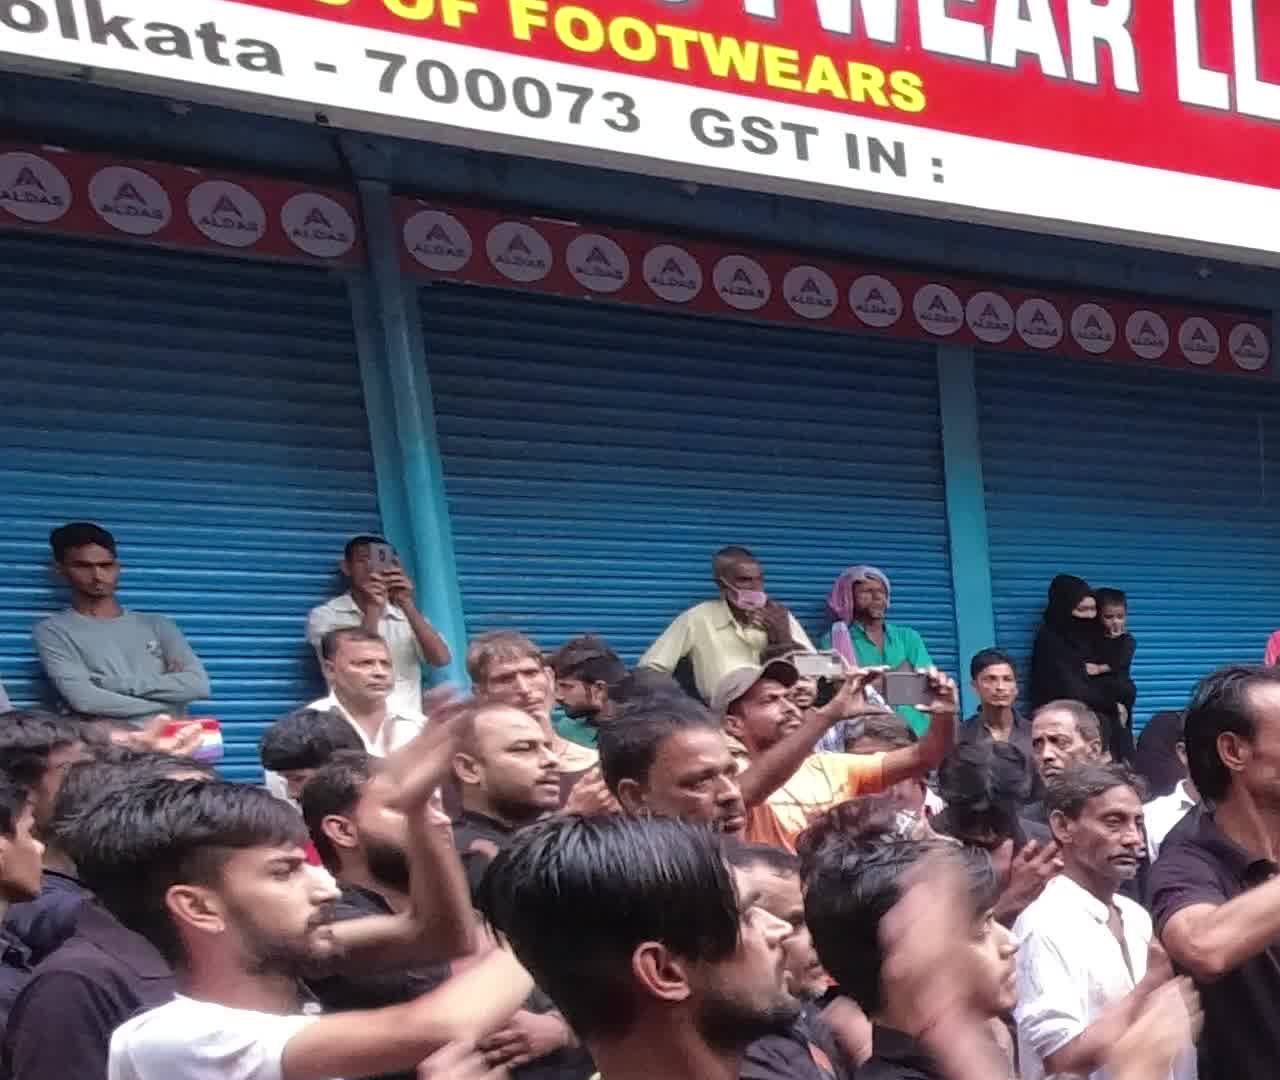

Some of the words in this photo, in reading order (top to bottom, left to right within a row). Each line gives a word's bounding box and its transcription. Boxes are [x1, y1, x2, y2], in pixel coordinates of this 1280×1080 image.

[364, 48, 641, 134] 700073
[689, 107, 819, 161] GST
[845, 132, 907, 178] IN
[510, 0, 926, 113] FOOTWEARS
